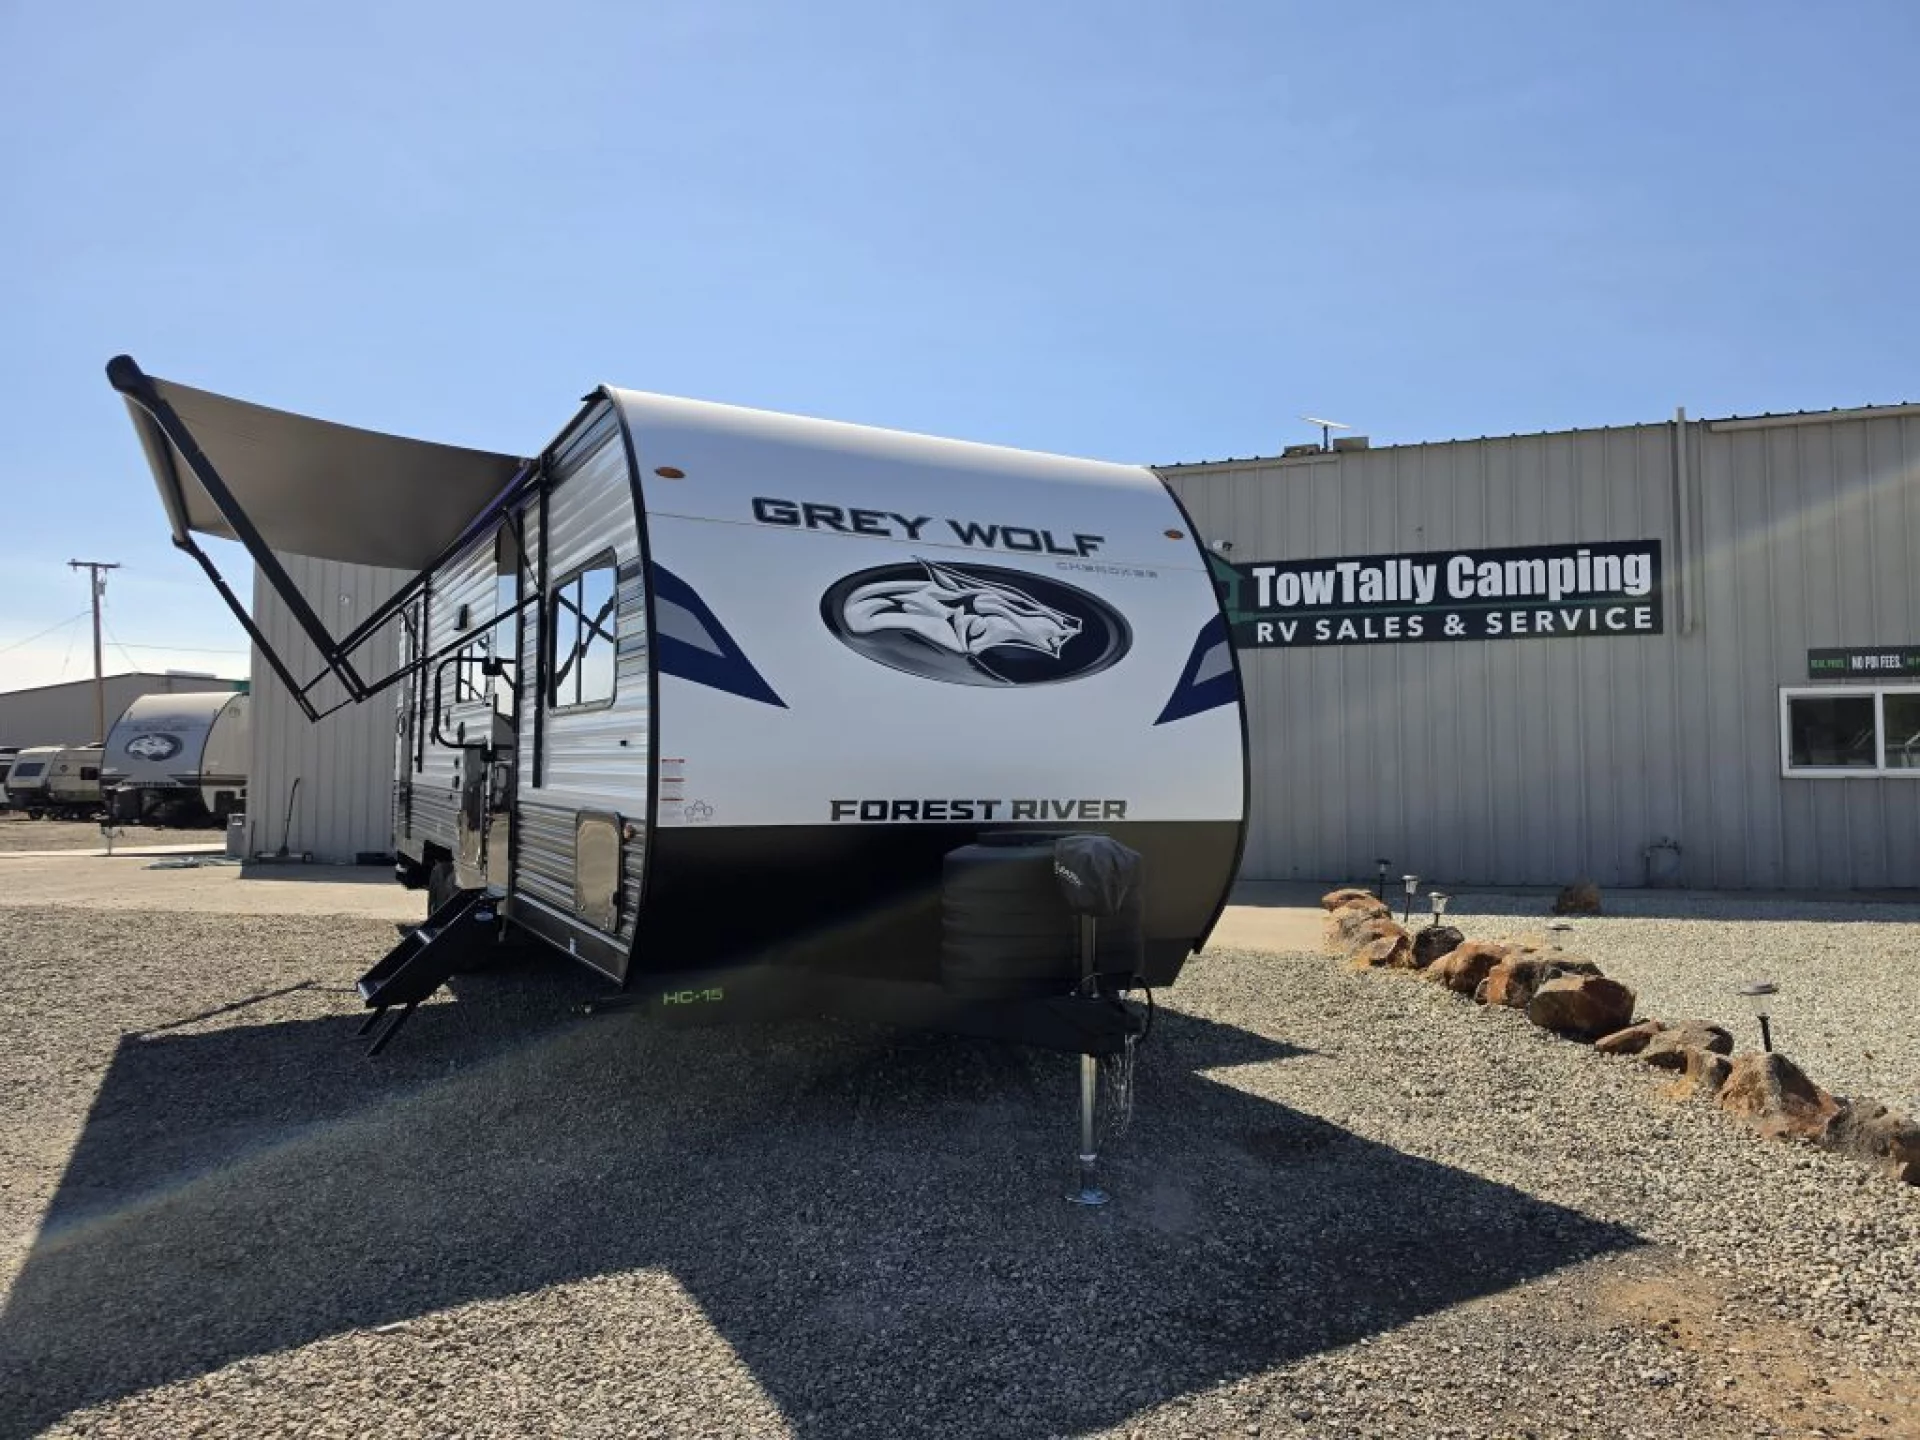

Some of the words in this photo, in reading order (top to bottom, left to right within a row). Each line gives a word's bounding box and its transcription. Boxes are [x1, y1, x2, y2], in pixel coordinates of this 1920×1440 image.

[752, 497, 931, 540] GREY
[945, 519, 1105, 557] WOLF
[1252, 559, 1437, 608] TowTally
[1447, 549, 1651, 601] Camping
[1257, 620, 1298, 643] RV
[1315, 615, 1424, 640] SALES
[1443, 613, 1466, 635] &
[1486, 606, 1653, 634] SERVICE
[830, 800, 1001, 821] FOREST
[1011, 800, 1127, 820] RIVER
